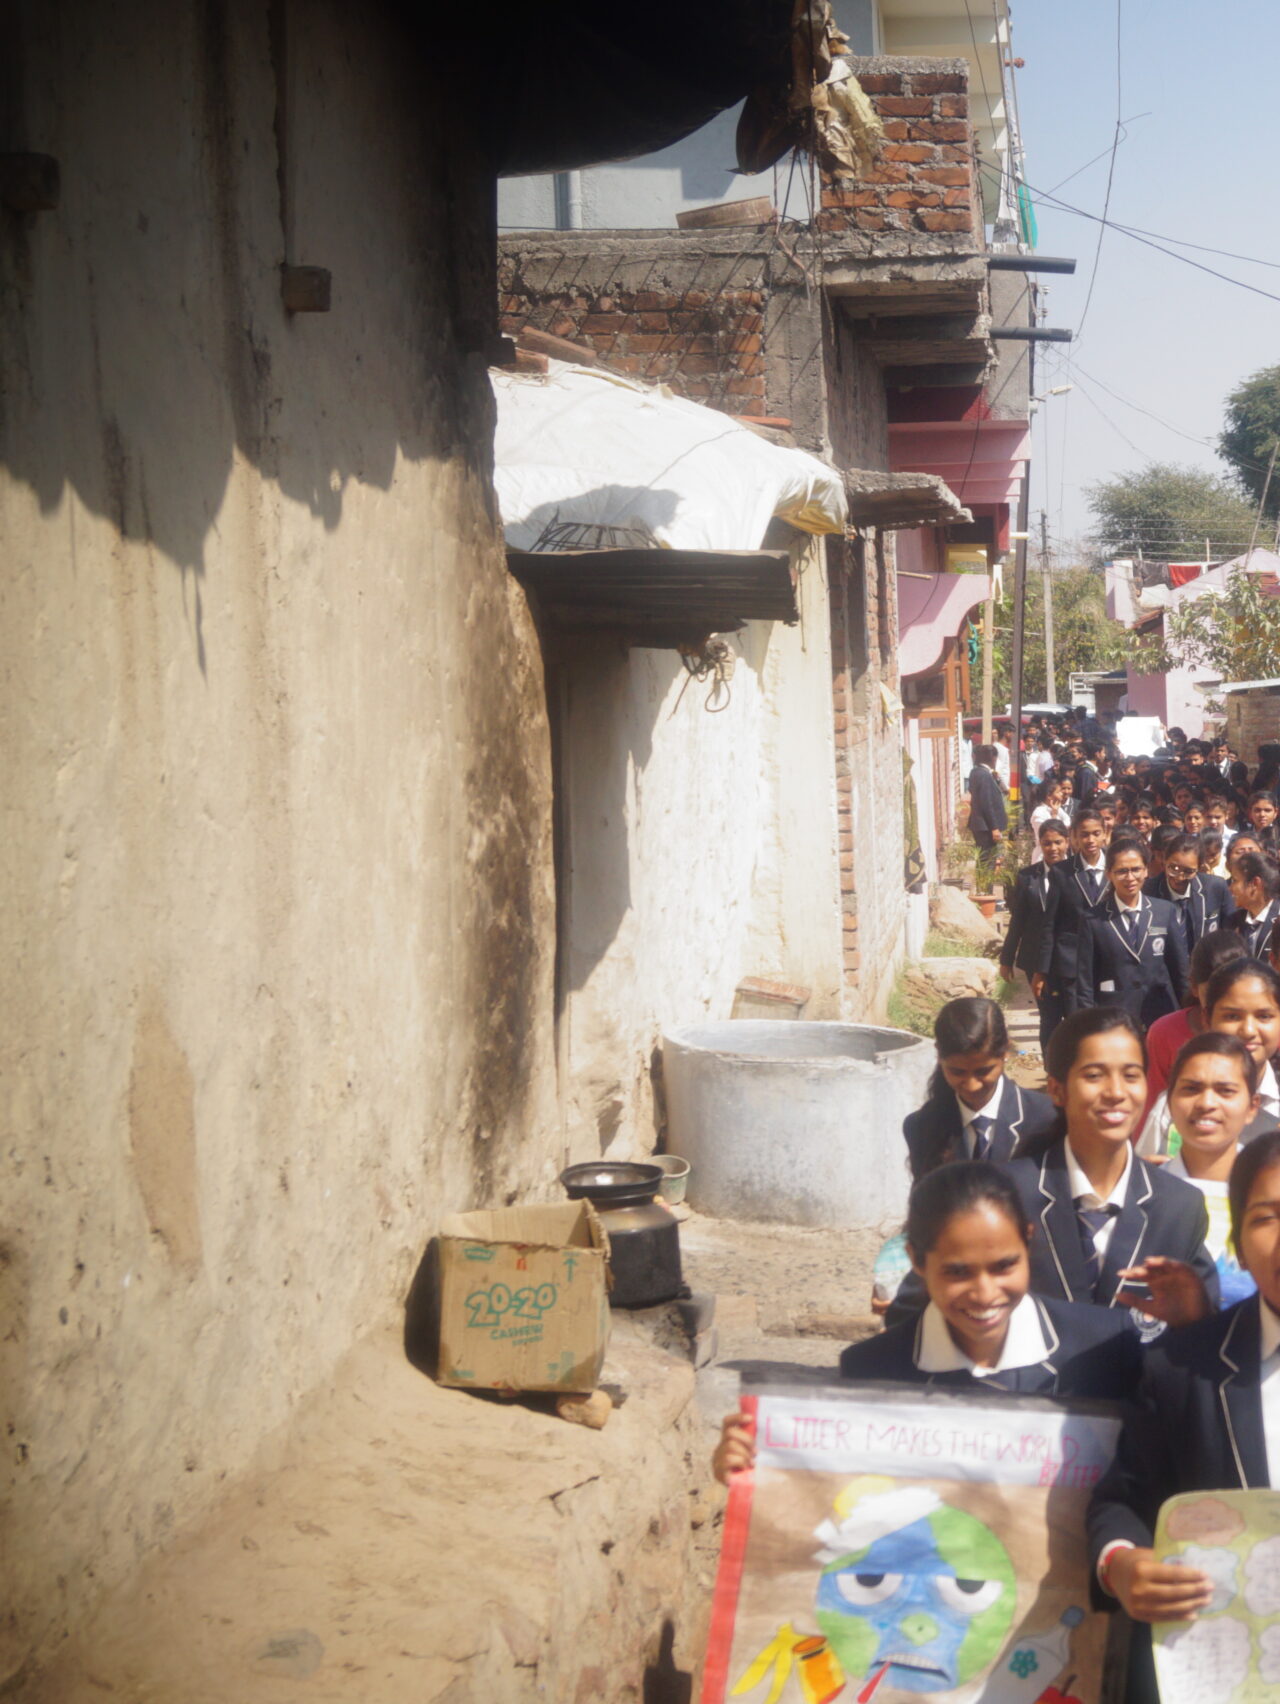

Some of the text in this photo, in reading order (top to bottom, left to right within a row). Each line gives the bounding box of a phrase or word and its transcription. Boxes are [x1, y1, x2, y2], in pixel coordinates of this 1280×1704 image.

[463, 1282, 558, 1328] 20-20
[765, 1416, 850, 1450] LITTER
[866, 1423, 942, 1457] MAKES
[949, 1430, 991, 1460] THE
